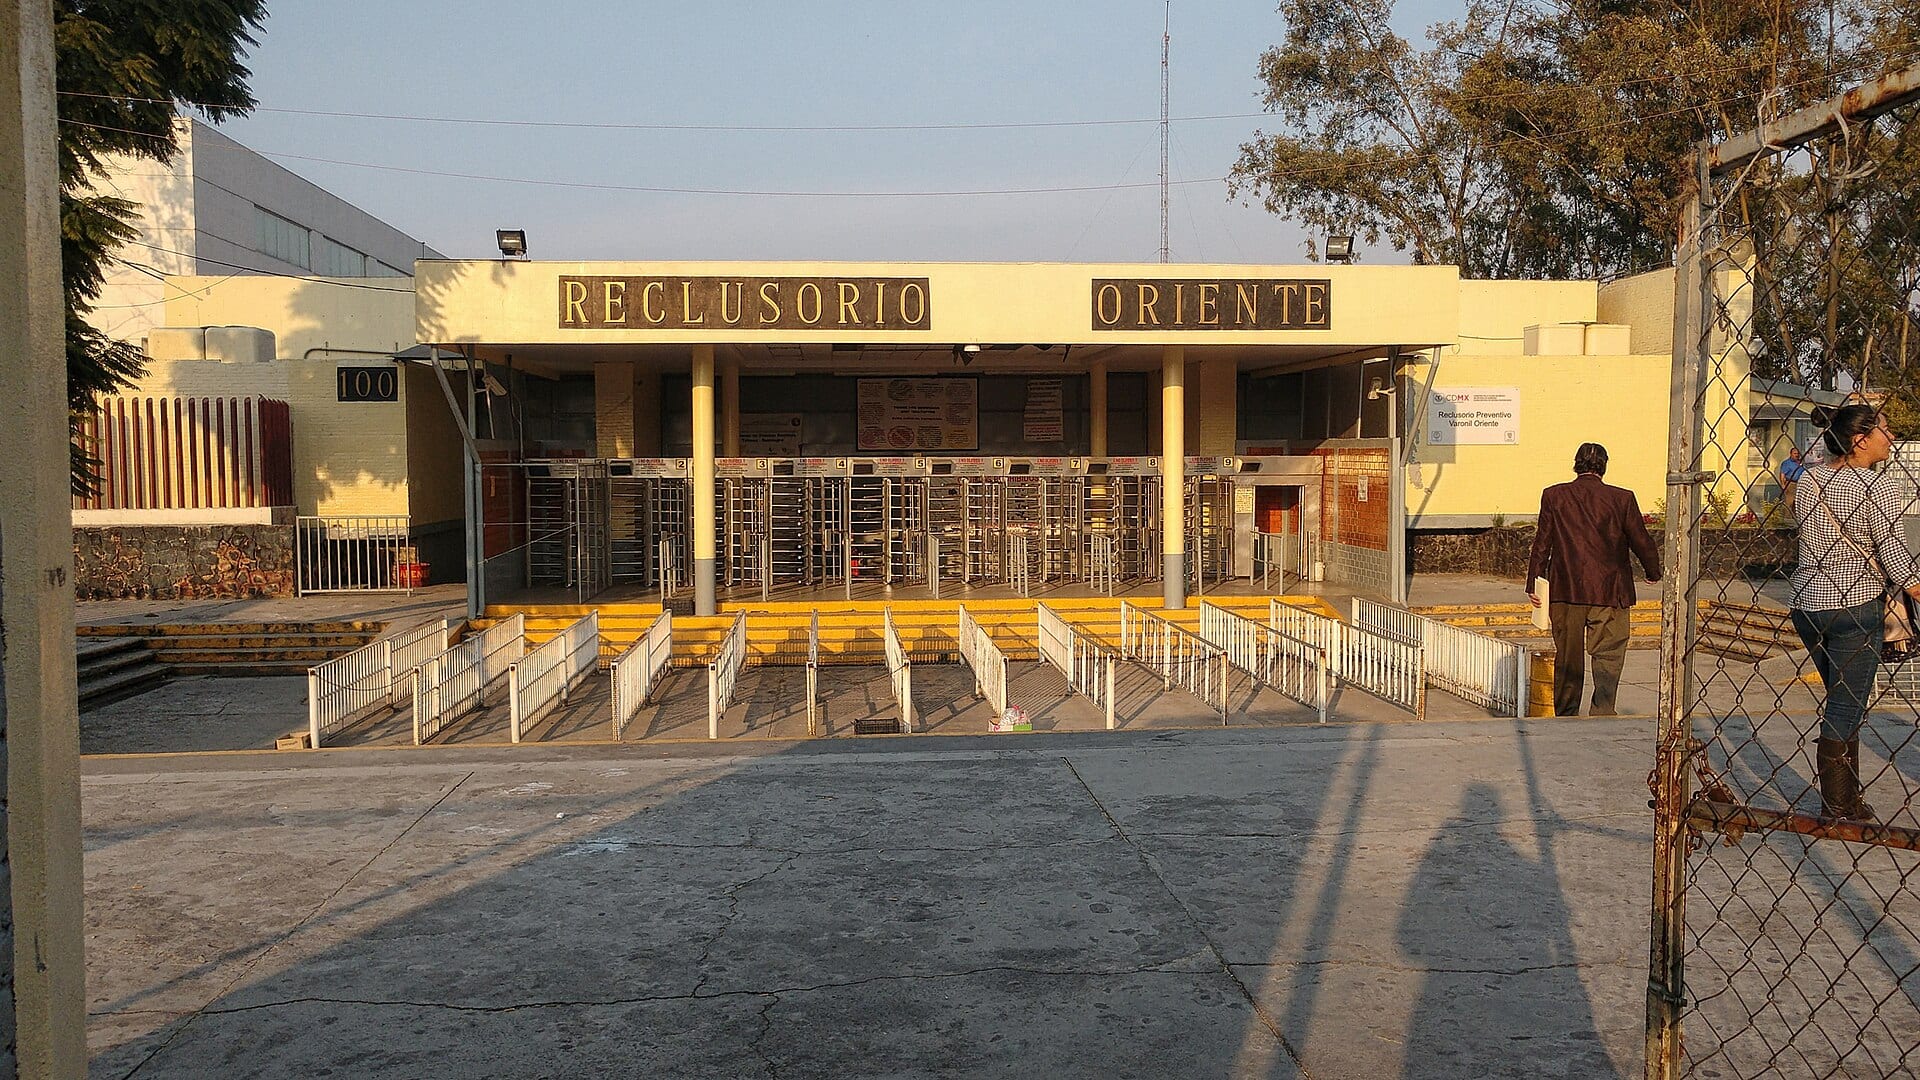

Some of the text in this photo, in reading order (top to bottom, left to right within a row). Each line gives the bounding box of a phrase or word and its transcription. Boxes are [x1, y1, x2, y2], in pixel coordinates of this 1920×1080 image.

[564, 281, 1326, 325] RECLUSORIO ORIENTE
[340, 370, 393, 398] 100
[1445, 394, 1470, 402] CDMX
[1438, 411, 1512, 419] Reclusorio Preventivo
[1473, 420, 1499, 428] Oriente
